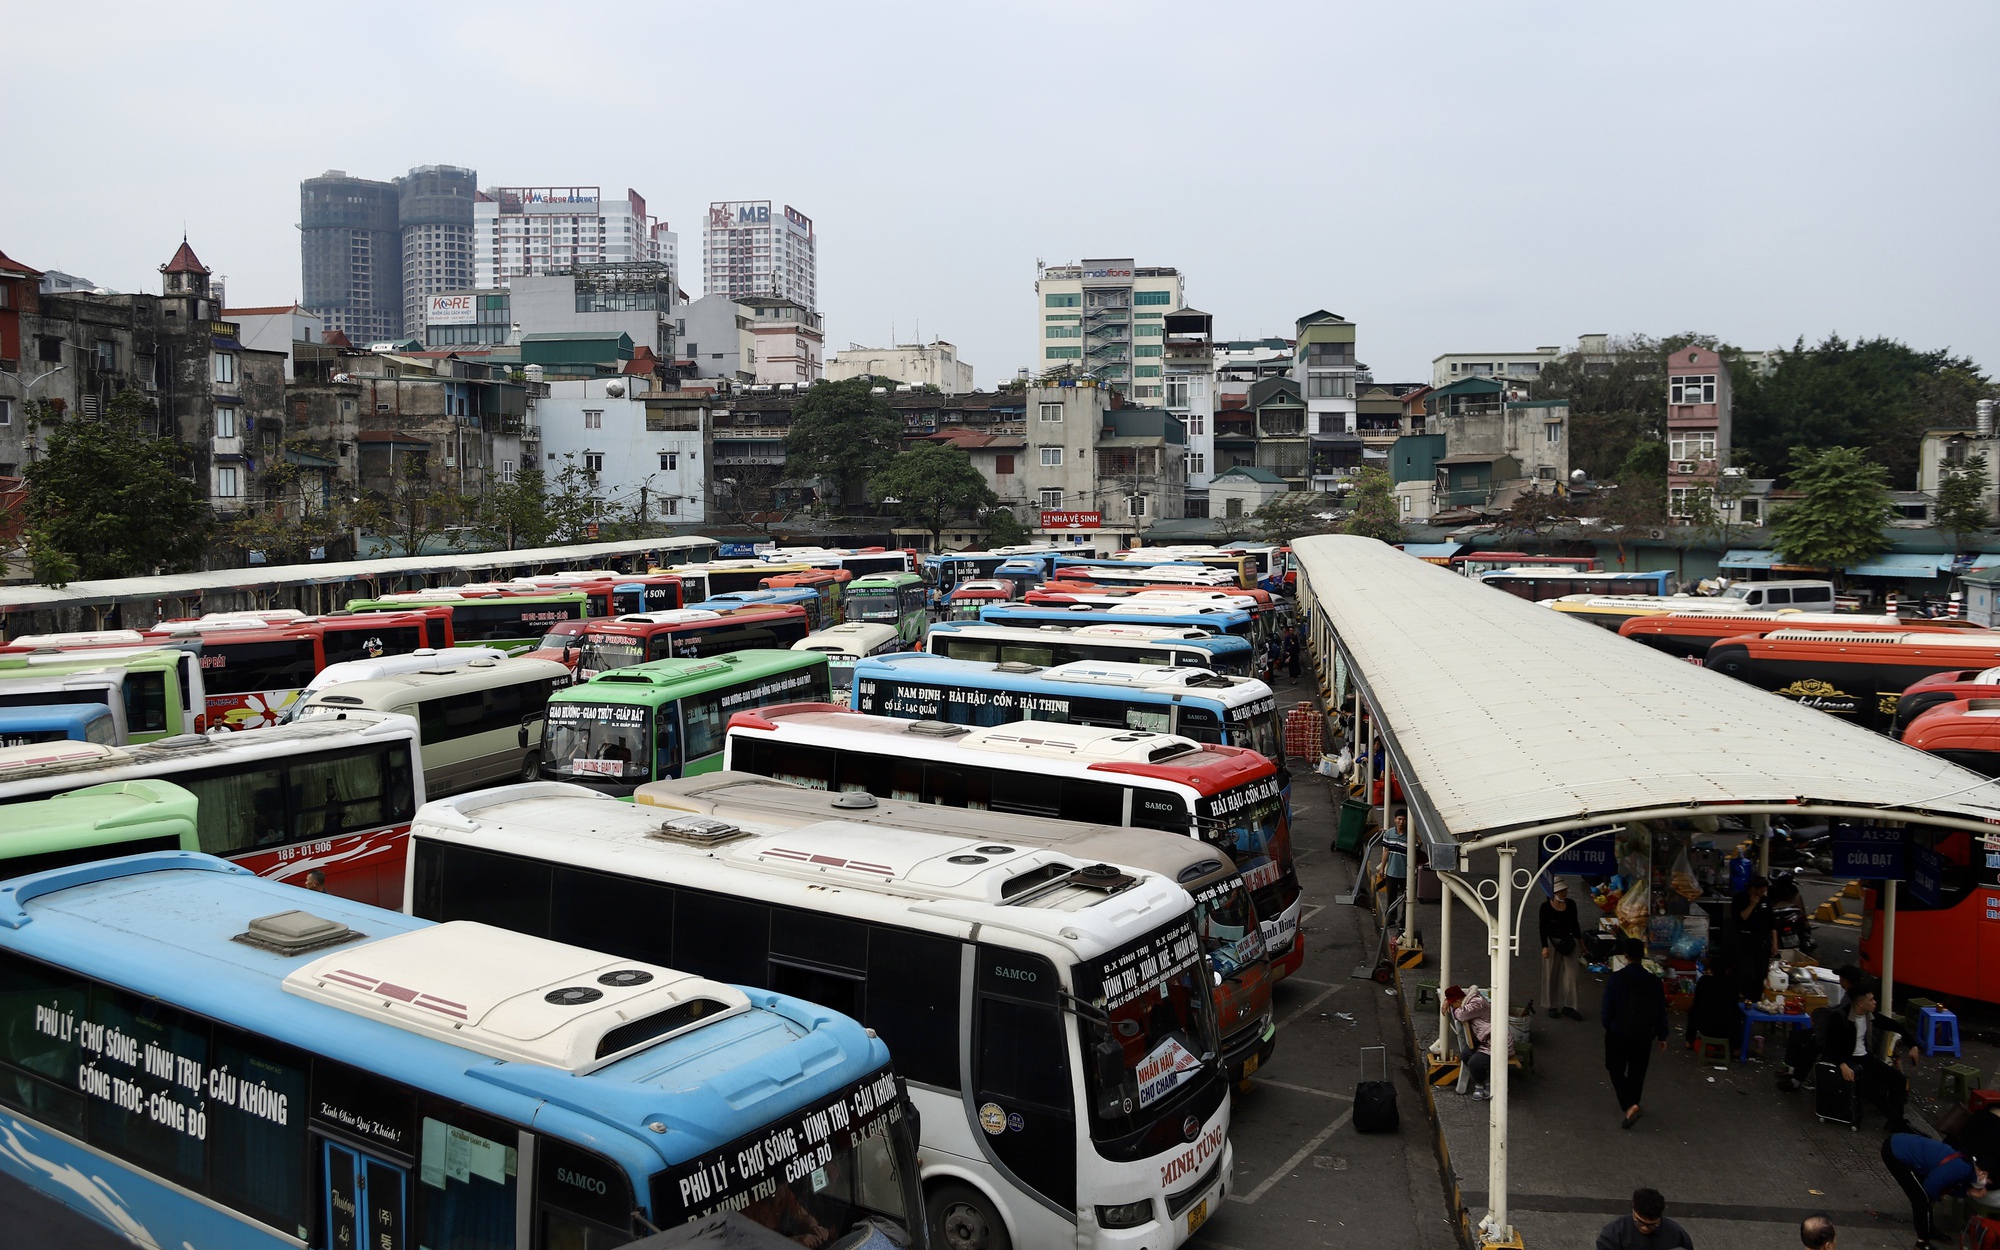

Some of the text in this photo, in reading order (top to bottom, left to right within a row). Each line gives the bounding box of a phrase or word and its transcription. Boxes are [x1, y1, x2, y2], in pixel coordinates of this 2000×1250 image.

[740, 206, 768, 222] MB
[1084, 268, 1130, 278] mobifone
[1052, 514, 1068, 522] NHÀ
[1070, 514, 1079, 523] VỆ
[650, 588, 665, 598] SƠN
[588, 634, 636, 645] VIỆT PHƯƠNG
[200, 654, 226, 668] IÁP BÁT
[897, 686, 917, 699] NAM
[919, 688, 941, 701] ĐỊNH
[949, 688, 965, 703] HẢI
[967, 690, 987, 707] HẬU
[1020, 695, 1037, 710] HẢI
[1039, 699, 1069, 714] THỊNH
[906, 703, 918, 714] LẠC
[550, 706, 560, 718] GIAO
[631, 708, 644, 721] BÁT
[1145, 802, 1173, 811] SAMCO
[1210, 793, 1228, 816] HẢI
[1862, 830, 1900, 840] A1-20
[1582, 850, 1606, 864] TRỤ
[1847, 850, 1893, 867] CỬA ĐẠT
[1156, 922, 1190, 947] B.X GIÁP BÁT
[1262, 917, 1295, 940] anh Hùng
[1104, 945, 1149, 973] B.X VĨNH TRỤ
[995, 966, 1037, 982] SAMCO
[1102, 976, 1123, 1000] VĨNH
[1122, 967, 1137, 990] TRỤ
[1108, 999, 1119, 1012] PHỦ
[36, 1000, 58, 1037] PHỦ
[60, 1009, 74, 1042] LÝ
[80, 1020, 105, 1059] CHỢ
[105, 1026, 138, 1067] SÔNG
[144, 1040, 174, 1081] VĨNH
[177, 1055, 202, 1097] TRỤ
[209, 1065, 236, 1106] CẦU
[239, 1080, 288, 1126] KHÔNG
[1138, 1060, 1160, 1085] NHÂN
[1160, 1052, 1174, 1072] HẬU
[79, 1061, 207, 1141] CỐNG TRÓC CỐNG ĐỎ
[1141, 1082, 1155, 1103] CHỢ
[321, 1102, 338, 1119] Kính
[357, 1115, 371, 1133] Quý
[371, 1121, 397, 1140] Khách
[850, 1128, 867, 1149] B.X
[868, 1111, 888, 1136] GIÁP
[679, 1161, 711, 1207] PHỦ
[711, 1155, 727, 1193] LÝ
[738, 1141, 765, 1178] CHỢ
[764, 1127, 798, 1166] SÔNG
[802, 1112, 831, 1145] VĨNH
[828, 1099, 850, 1131] TRỤ
[873, 1072, 898, 1104] KHÔNG
[785, 1138, 832, 1184] CỐNG ĐỎ
[1161, 1125, 1222, 1188] MINH TÙNG
[558, 1168, 606, 1195] SAMCO
[716, 1176, 777, 1212] VĨNH TRỤ
